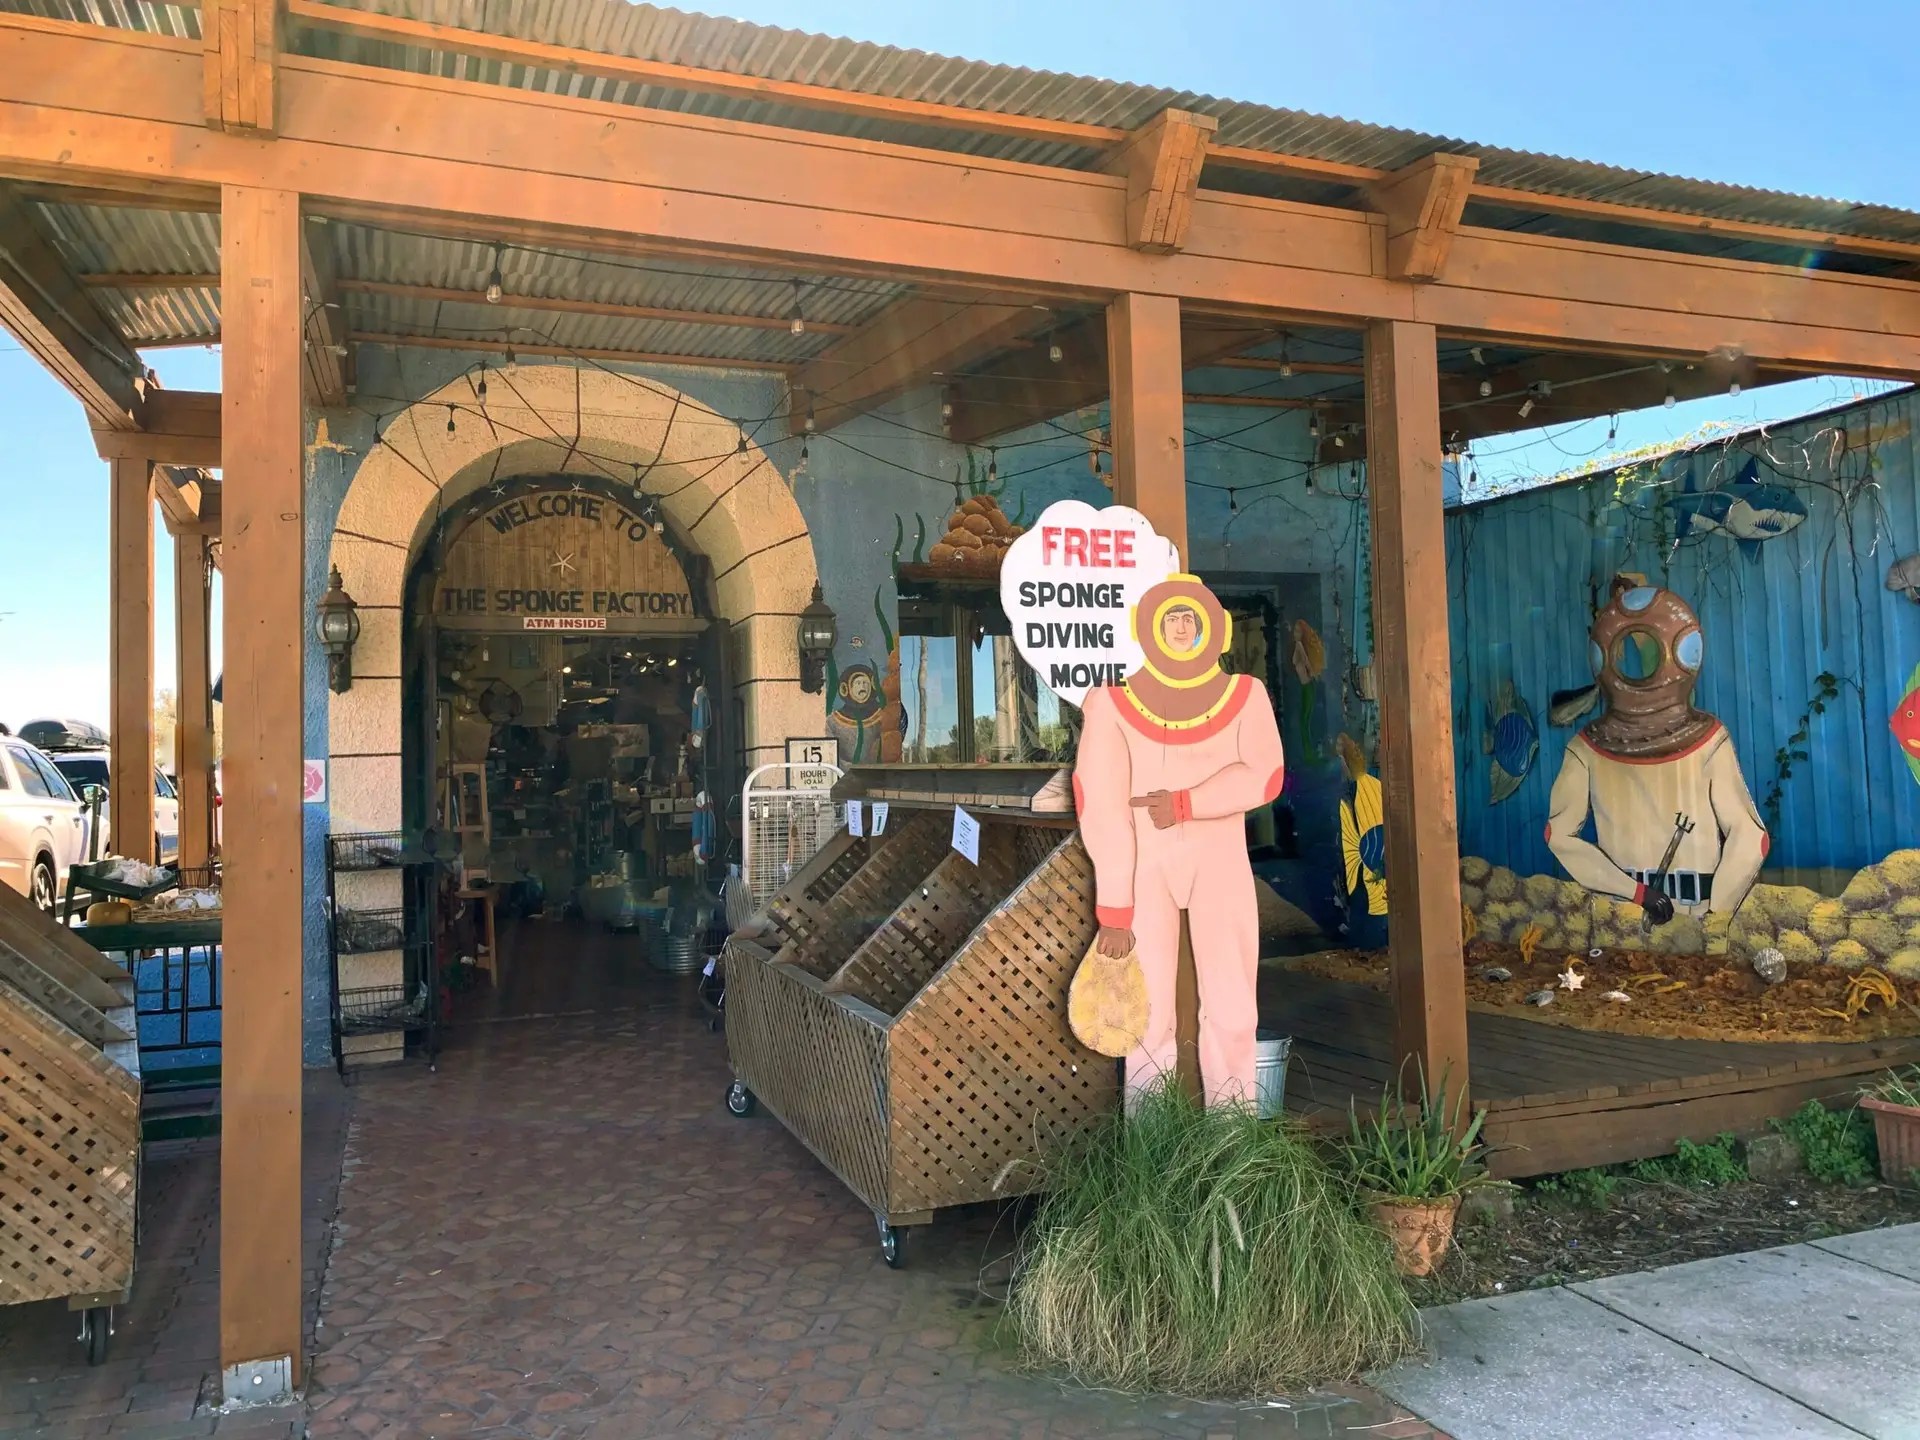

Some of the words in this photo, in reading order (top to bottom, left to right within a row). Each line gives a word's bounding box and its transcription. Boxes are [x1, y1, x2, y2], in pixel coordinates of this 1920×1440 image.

[486, 494, 605, 534] WELCOME
[615, 509, 647, 542] TO
[1042, 526, 1137, 568] FREE
[441, 588, 487, 612] THE
[496, 589, 584, 613] SPONGE
[592, 591, 688, 614] FACTORY
[1019, 581, 1125, 609] SPONGE
[525, 618, 556, 629] ATM
[559, 618, 606, 629] INSIDE
[1026, 622, 1114, 648] DIVING
[1050, 663, 1127, 688] MOVIE
[800, 770, 827, 779] HOURS
